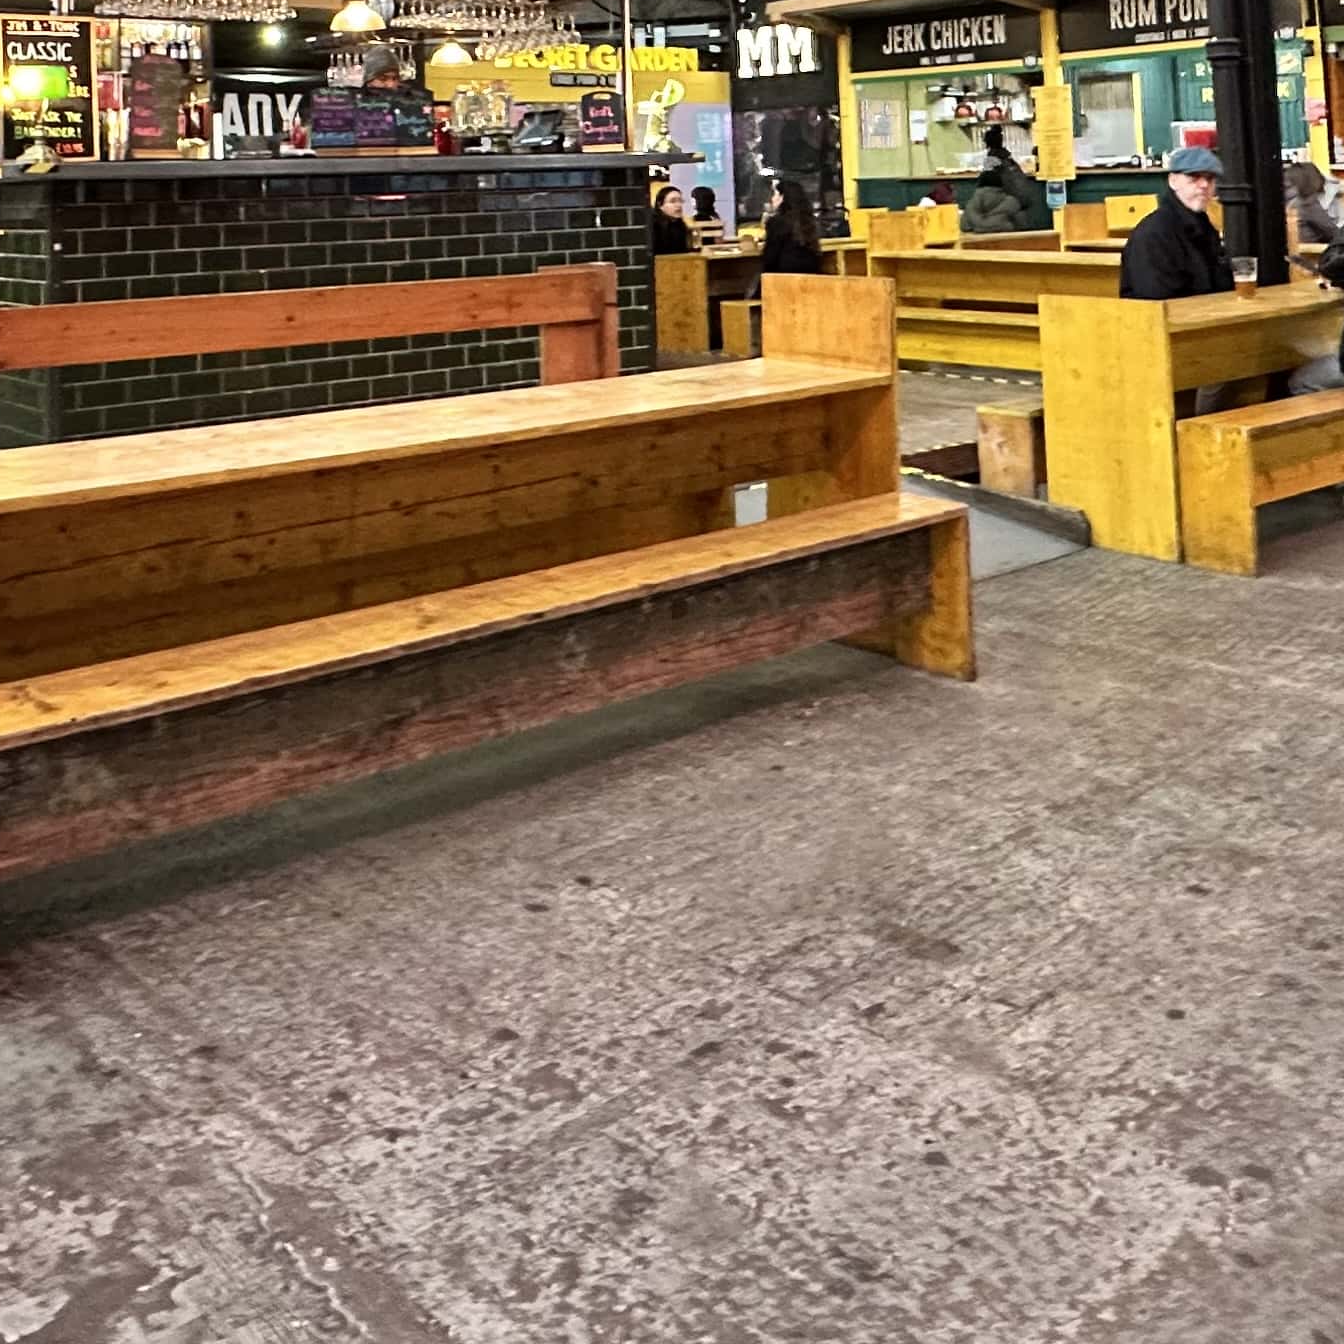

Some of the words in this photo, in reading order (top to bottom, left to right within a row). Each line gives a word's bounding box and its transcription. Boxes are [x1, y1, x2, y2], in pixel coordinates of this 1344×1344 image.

[6, 41, 73, 62] CLASSIC
[736, 24, 816, 78] MM
[882, 23, 926, 55] JERK
[930, 15, 1007, 51] CHICKEN
